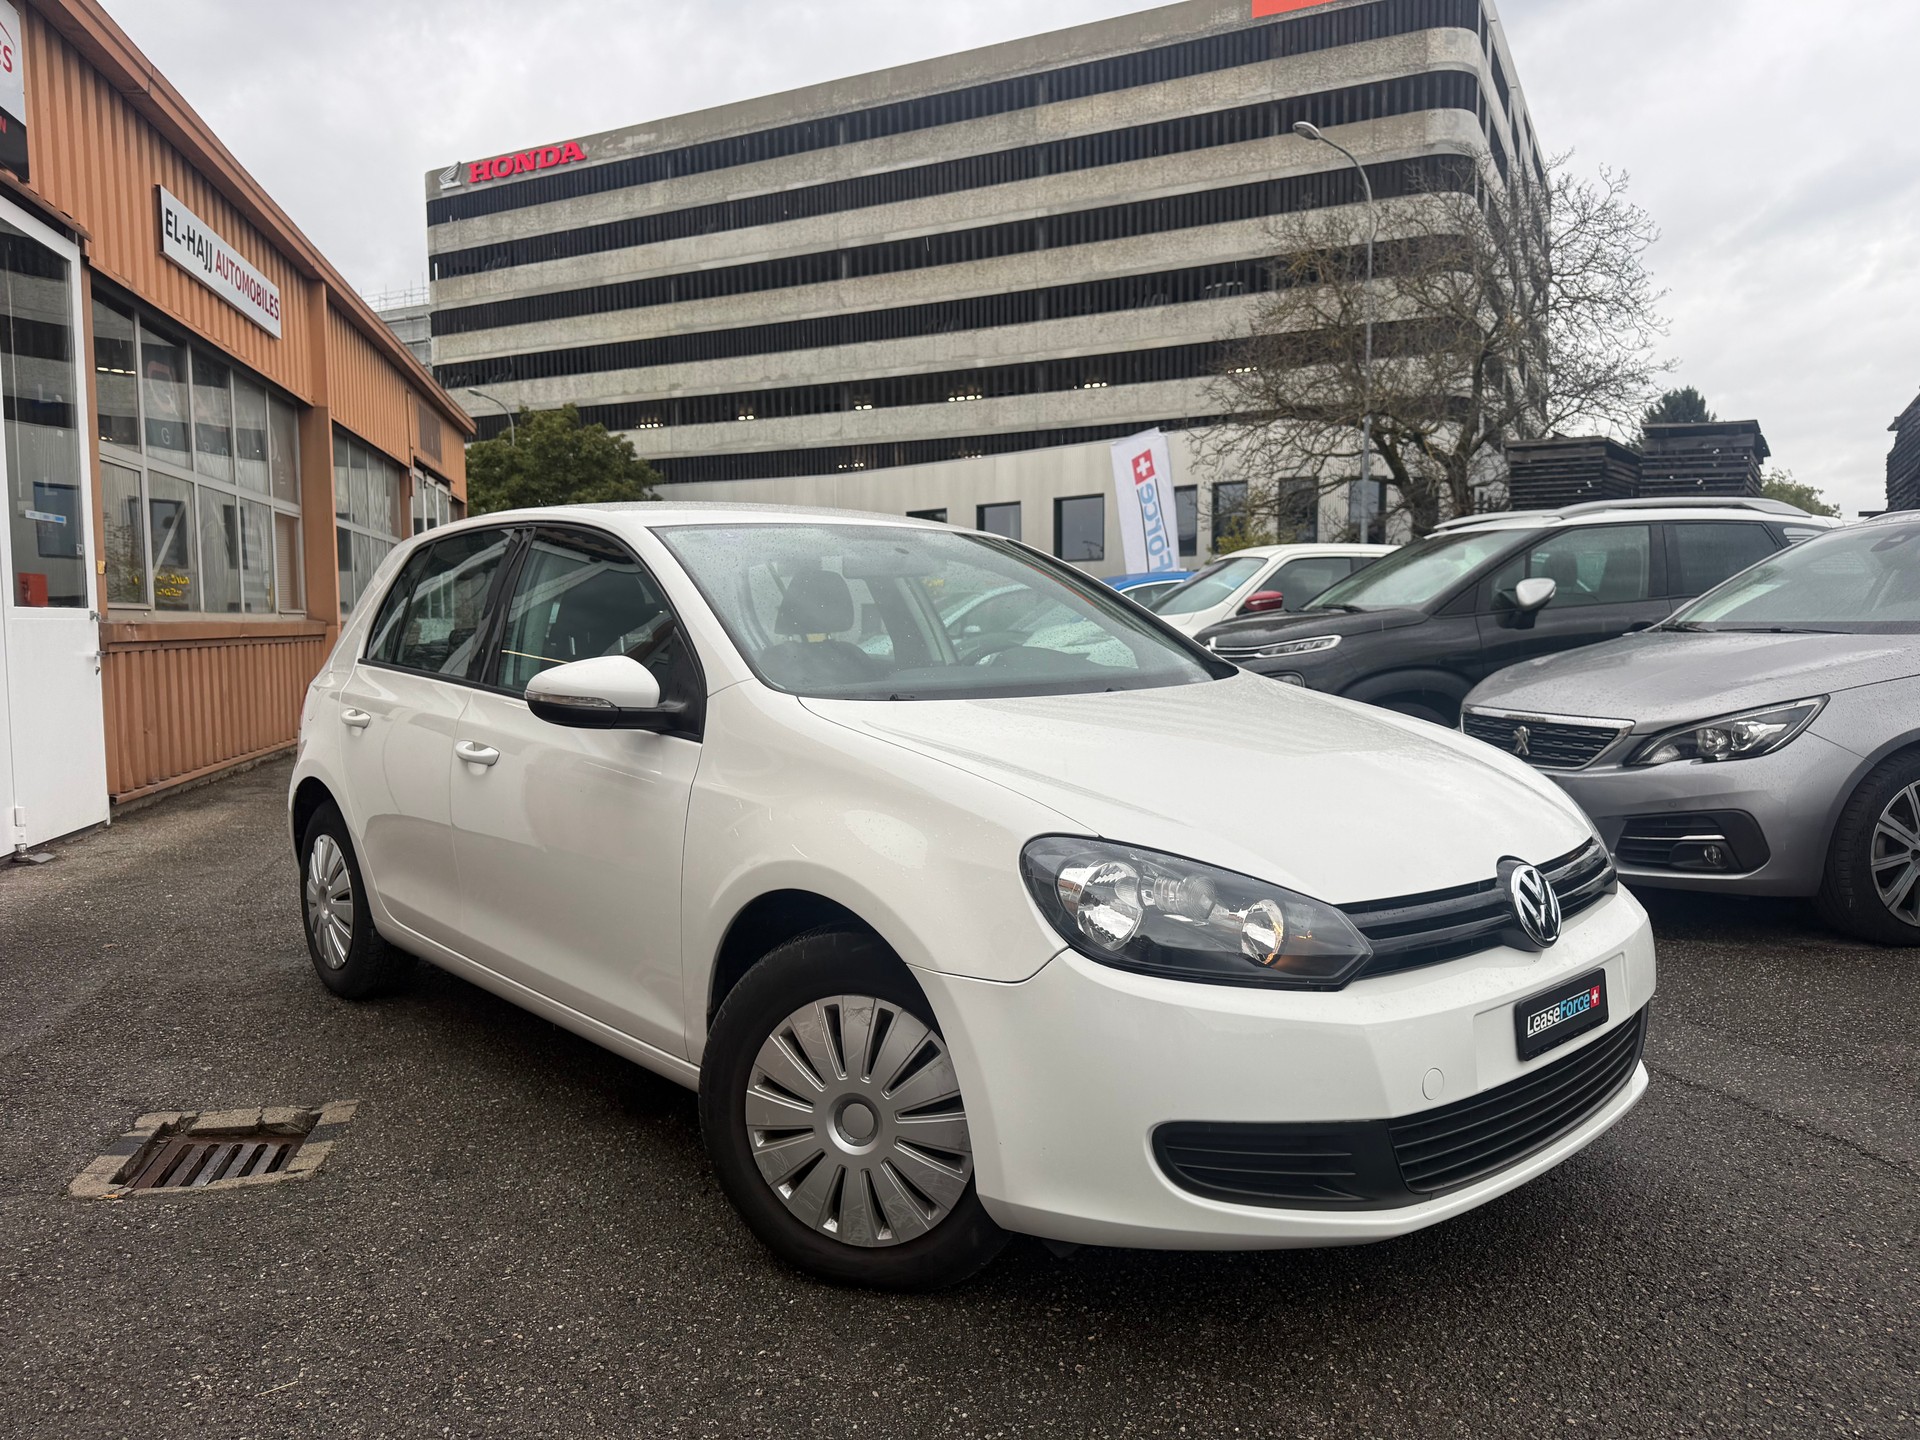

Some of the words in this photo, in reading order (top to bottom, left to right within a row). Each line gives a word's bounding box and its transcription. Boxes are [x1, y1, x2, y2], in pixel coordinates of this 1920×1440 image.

[468, 141, 587, 183] HONDA
[165, 207, 213, 273] EL-HAJJ
[215, 249, 279, 320] AUTOMOBILES
[1527, 992, 1591, 1036] LeaseForce
